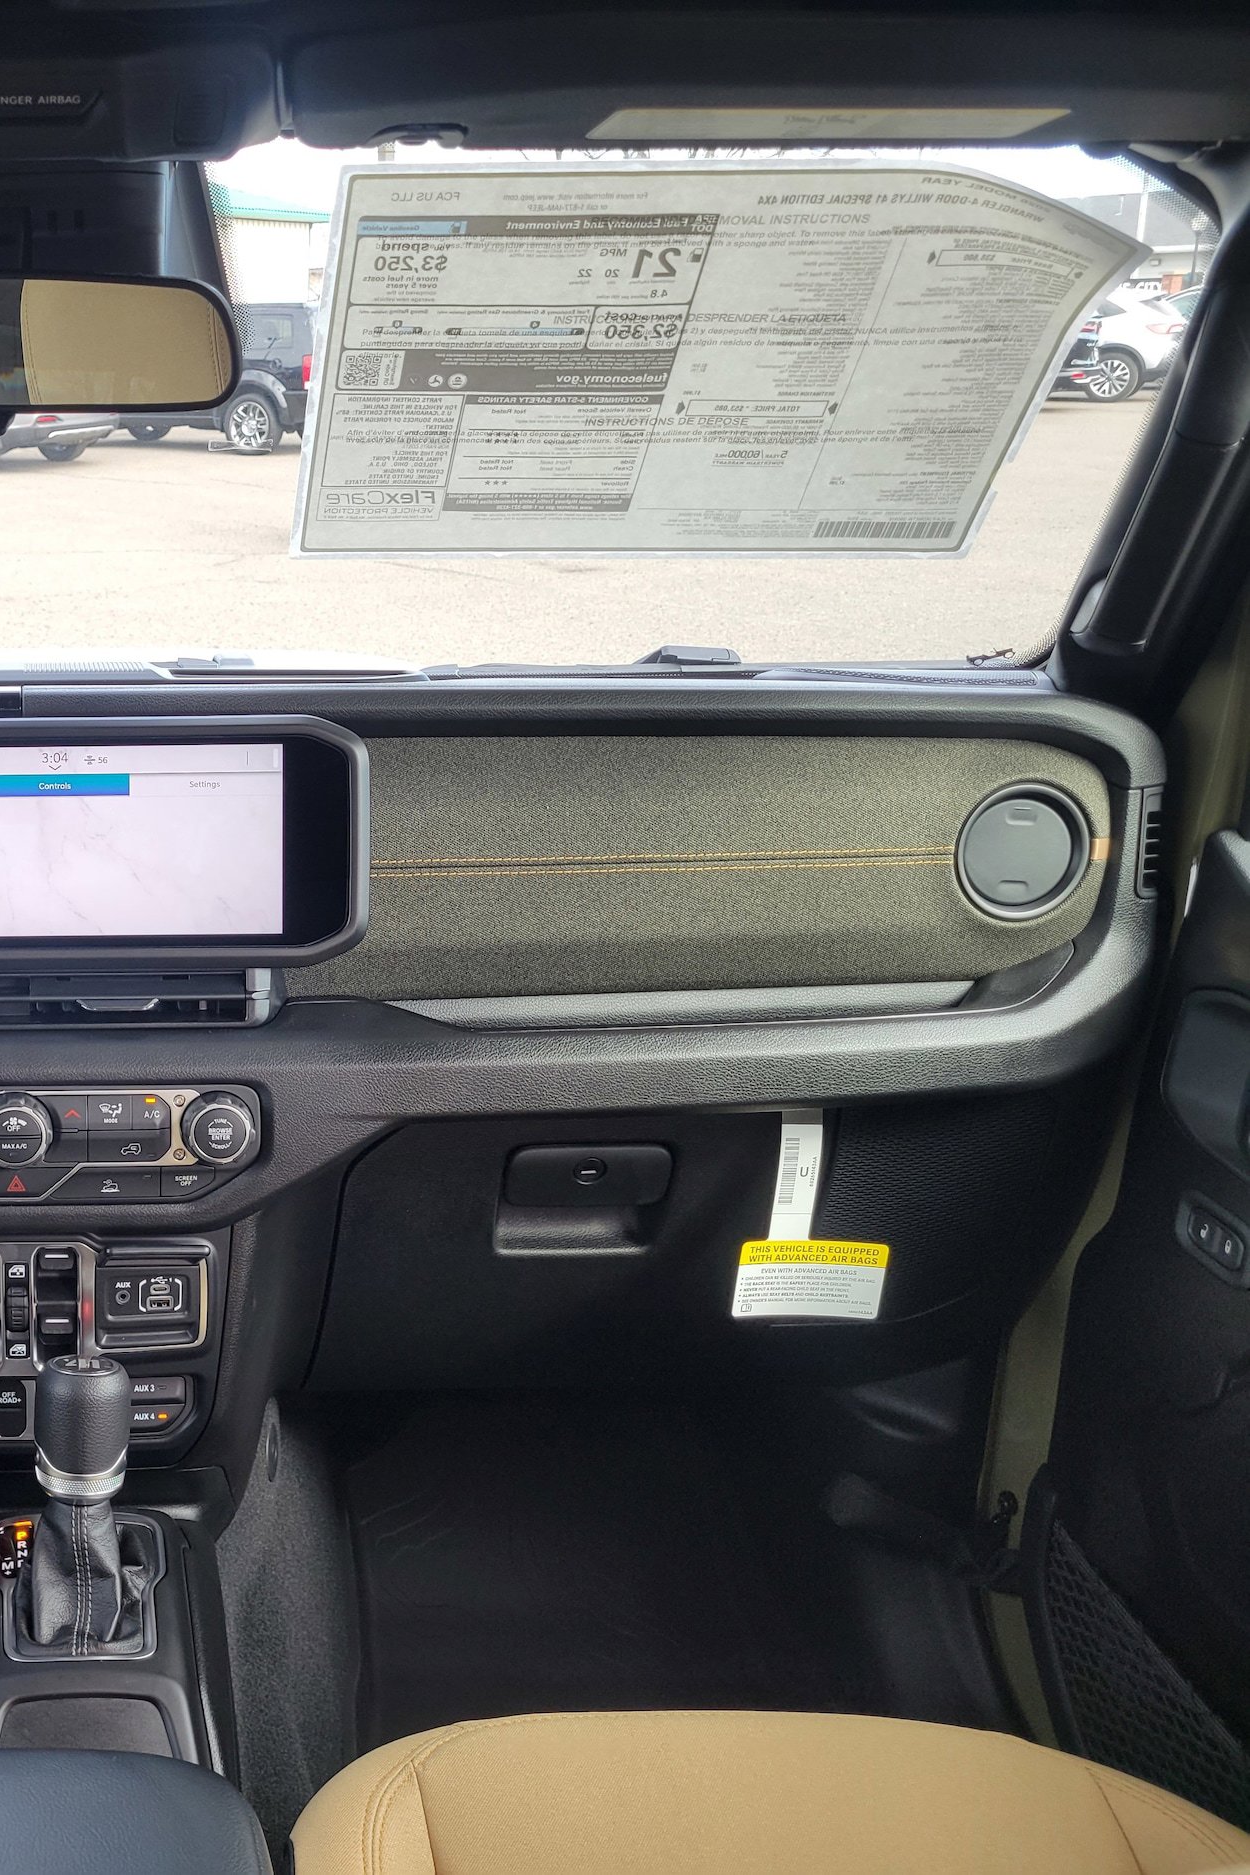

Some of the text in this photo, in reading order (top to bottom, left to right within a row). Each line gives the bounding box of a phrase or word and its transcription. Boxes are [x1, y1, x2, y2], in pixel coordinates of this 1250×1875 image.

[38, 95, 80, 104] AIRBAG
[769, 214, 870, 224] INSTRUCTIONS
[687, 314, 768, 323] DESPRENDER
[585, 418, 673, 426] INSTRUCTIONS
[677, 418, 694, 426] DE
[42, 752, 68, 763] 3:04
[144, 1110, 160, 1118] A/C
[800, 1166, 809, 1177] U
[750, 1245, 771, 1254] THIS
[773, 1245, 814, 1253] VEHICLE
[828, 1246, 879, 1256] EQUIPPED
[775, 1254, 828, 1262] ADVANCED
[831, 1255, 848, 1263] AIR
[851, 1256, 878, 1265] BAGS
[16, 1532, 27, 1540] P
[17, 1541, 27, 1549] R
[17, 1549, 28, 1558] N
[2, 1561, 14, 1570] M
